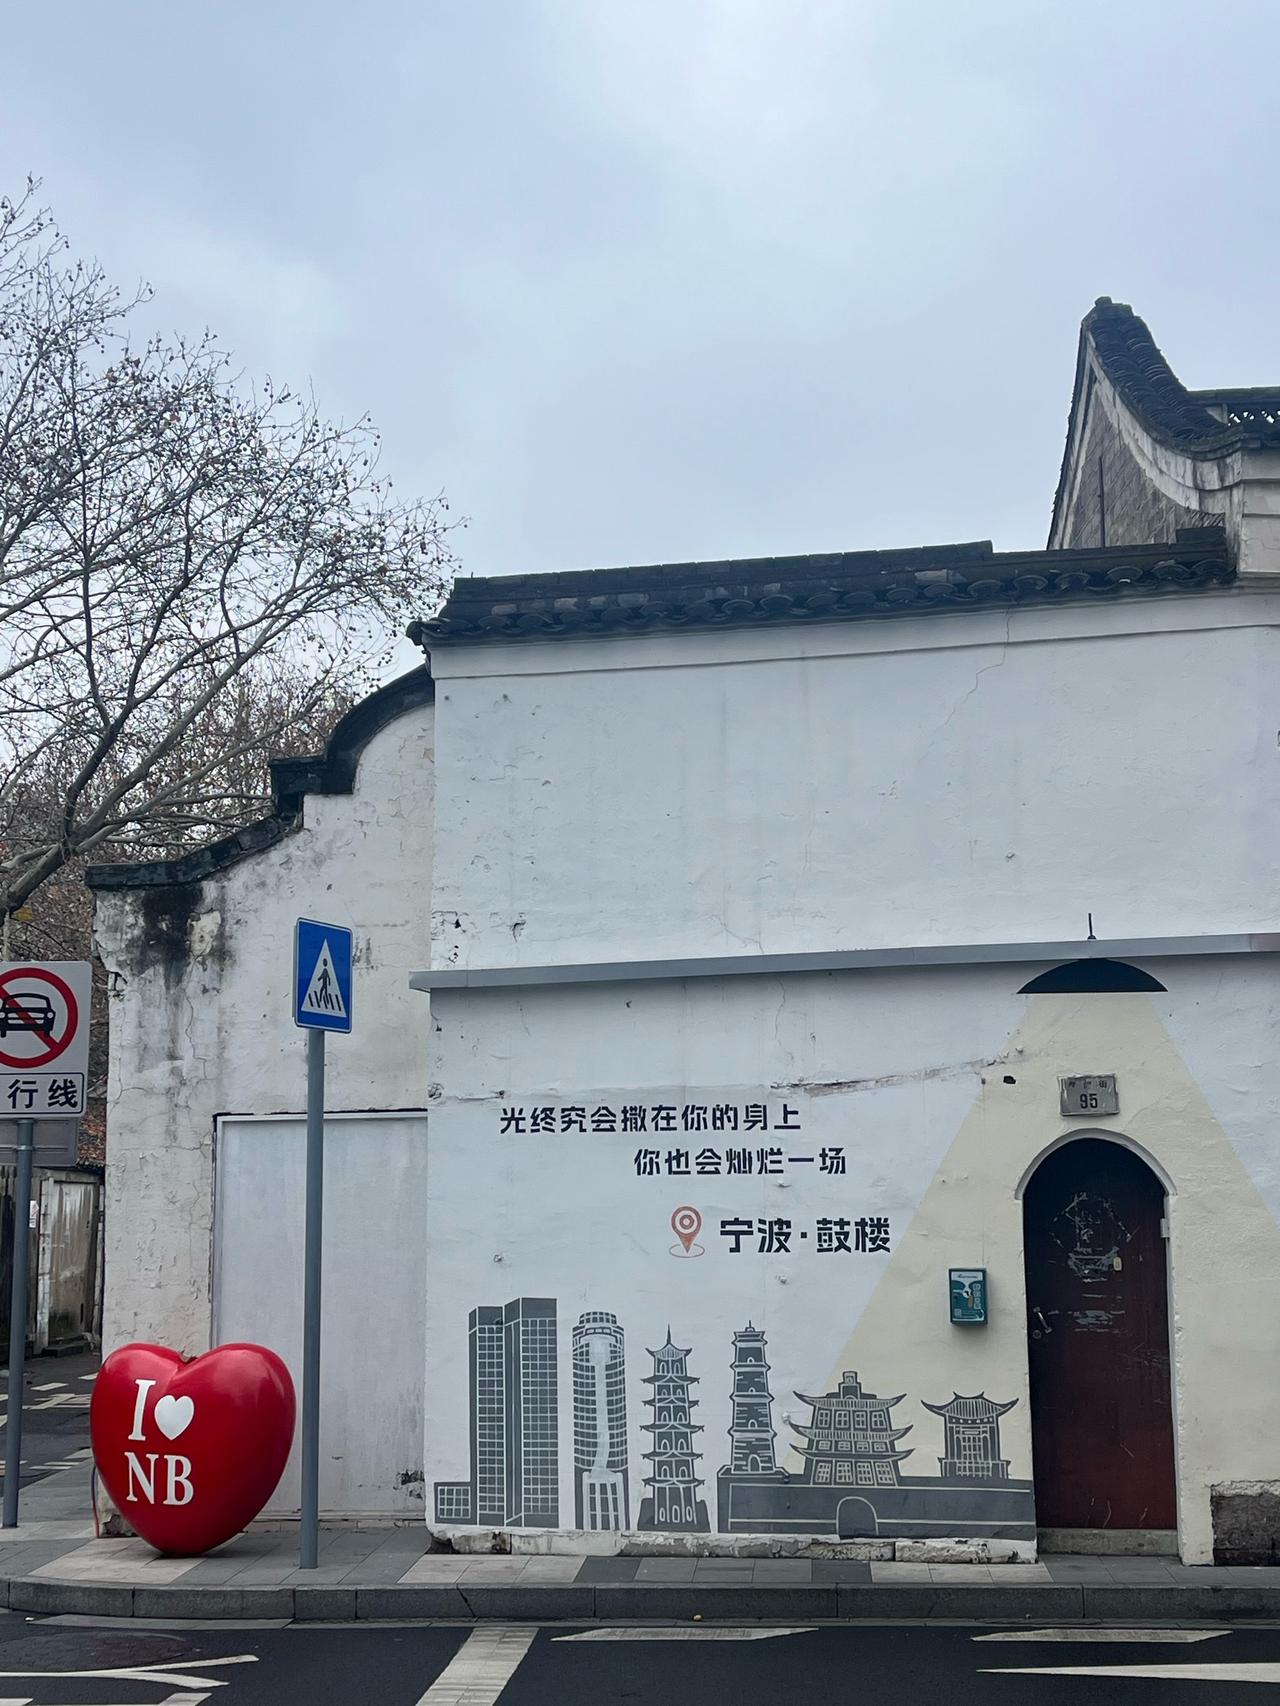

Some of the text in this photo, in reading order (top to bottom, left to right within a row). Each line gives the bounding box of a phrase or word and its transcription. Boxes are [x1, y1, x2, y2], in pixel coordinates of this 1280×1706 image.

[8, 1078, 78, 1109] 行线
[1079, 1093, 1098, 1109] 95
[500, 1104, 801, 1134] 光终究会撒在你的身上
[634, 1147, 847, 1176] 你也会灿烂一场
[128, 1379, 157, 1441] I
[124, 1452, 194, 1506] NB
